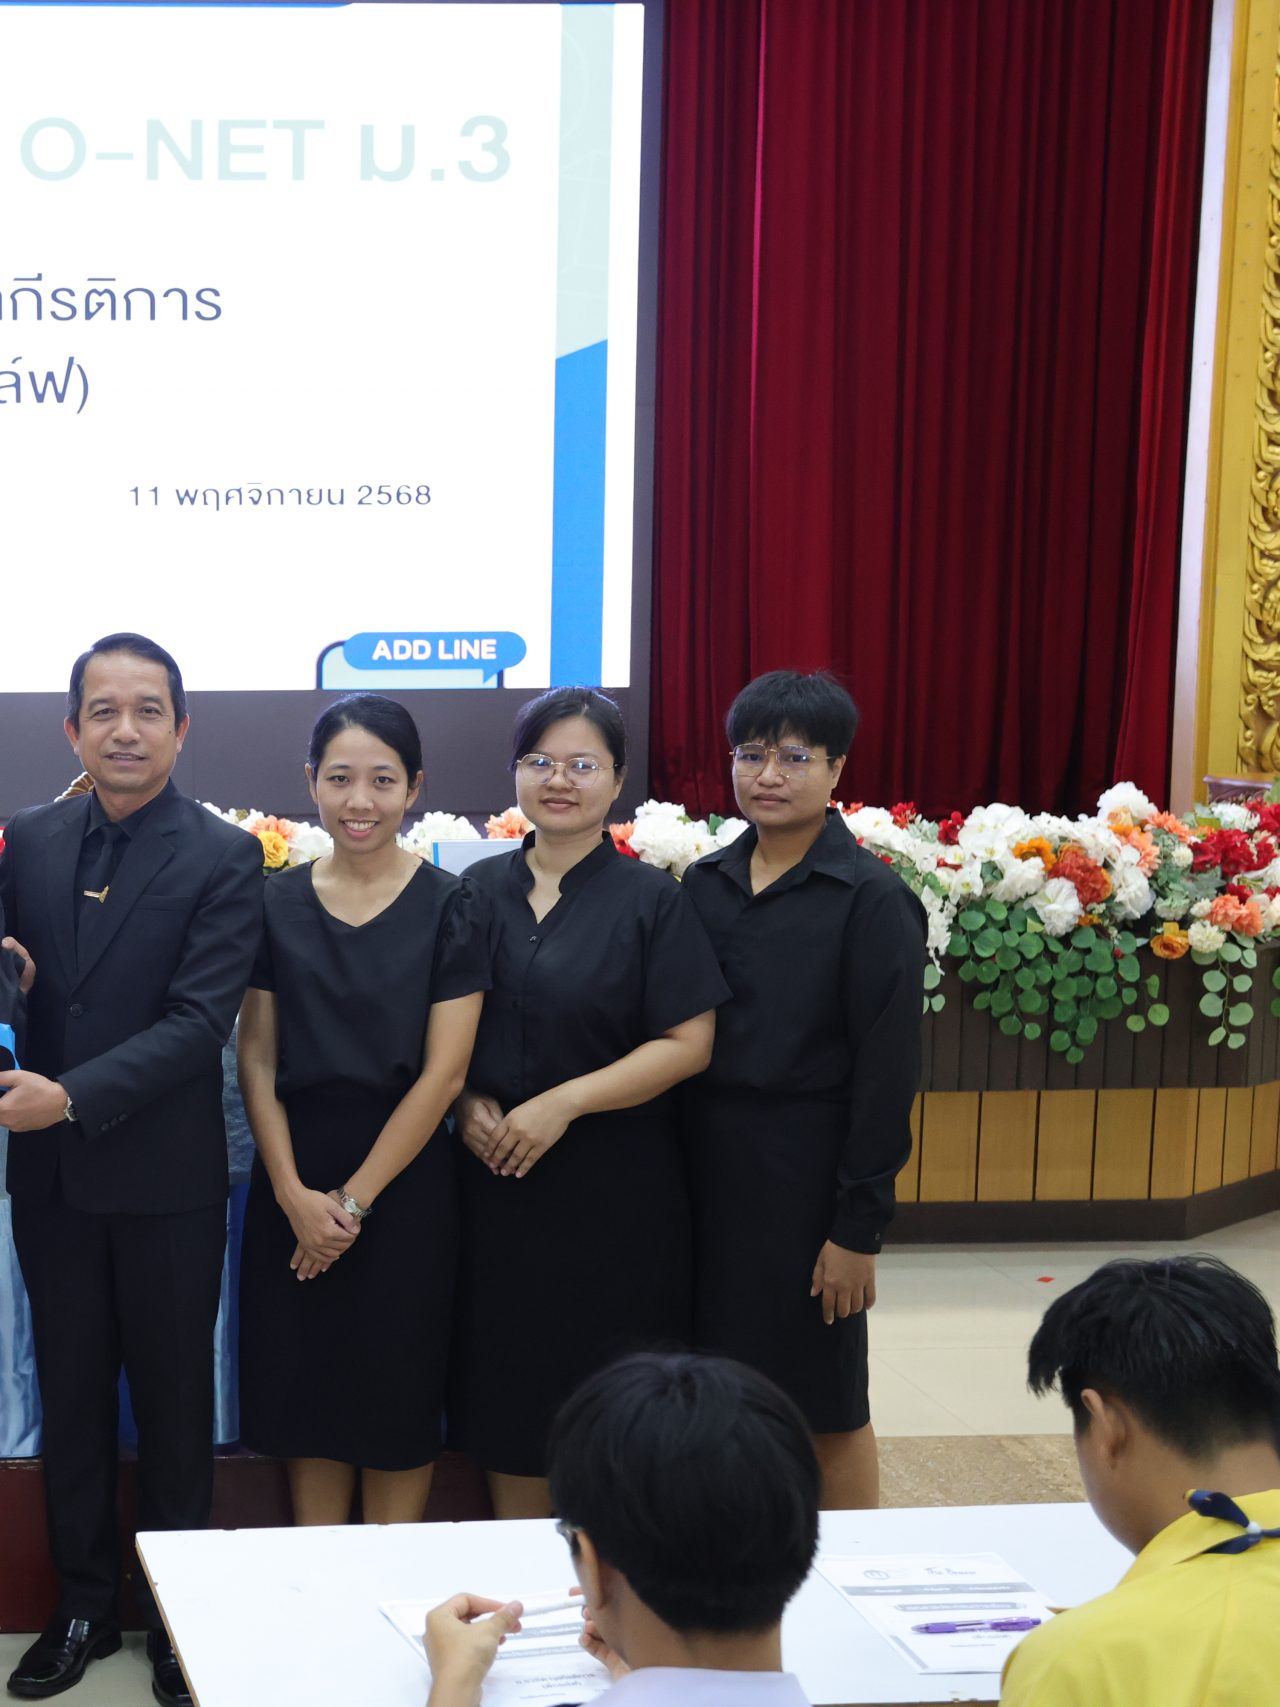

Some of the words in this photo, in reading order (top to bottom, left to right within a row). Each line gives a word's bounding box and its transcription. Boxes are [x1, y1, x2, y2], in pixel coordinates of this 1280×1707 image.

[20, 116, 325, 182] O-NET
[360, 115, 511, 183] ม.3
[129, 485, 158, 506] 11
[175, 482, 345, 512] พฤศจิกายน
[357, 484, 432, 506] 2568
[372, 639, 431, 661] ADD
[438, 638, 497, 660] LINE
